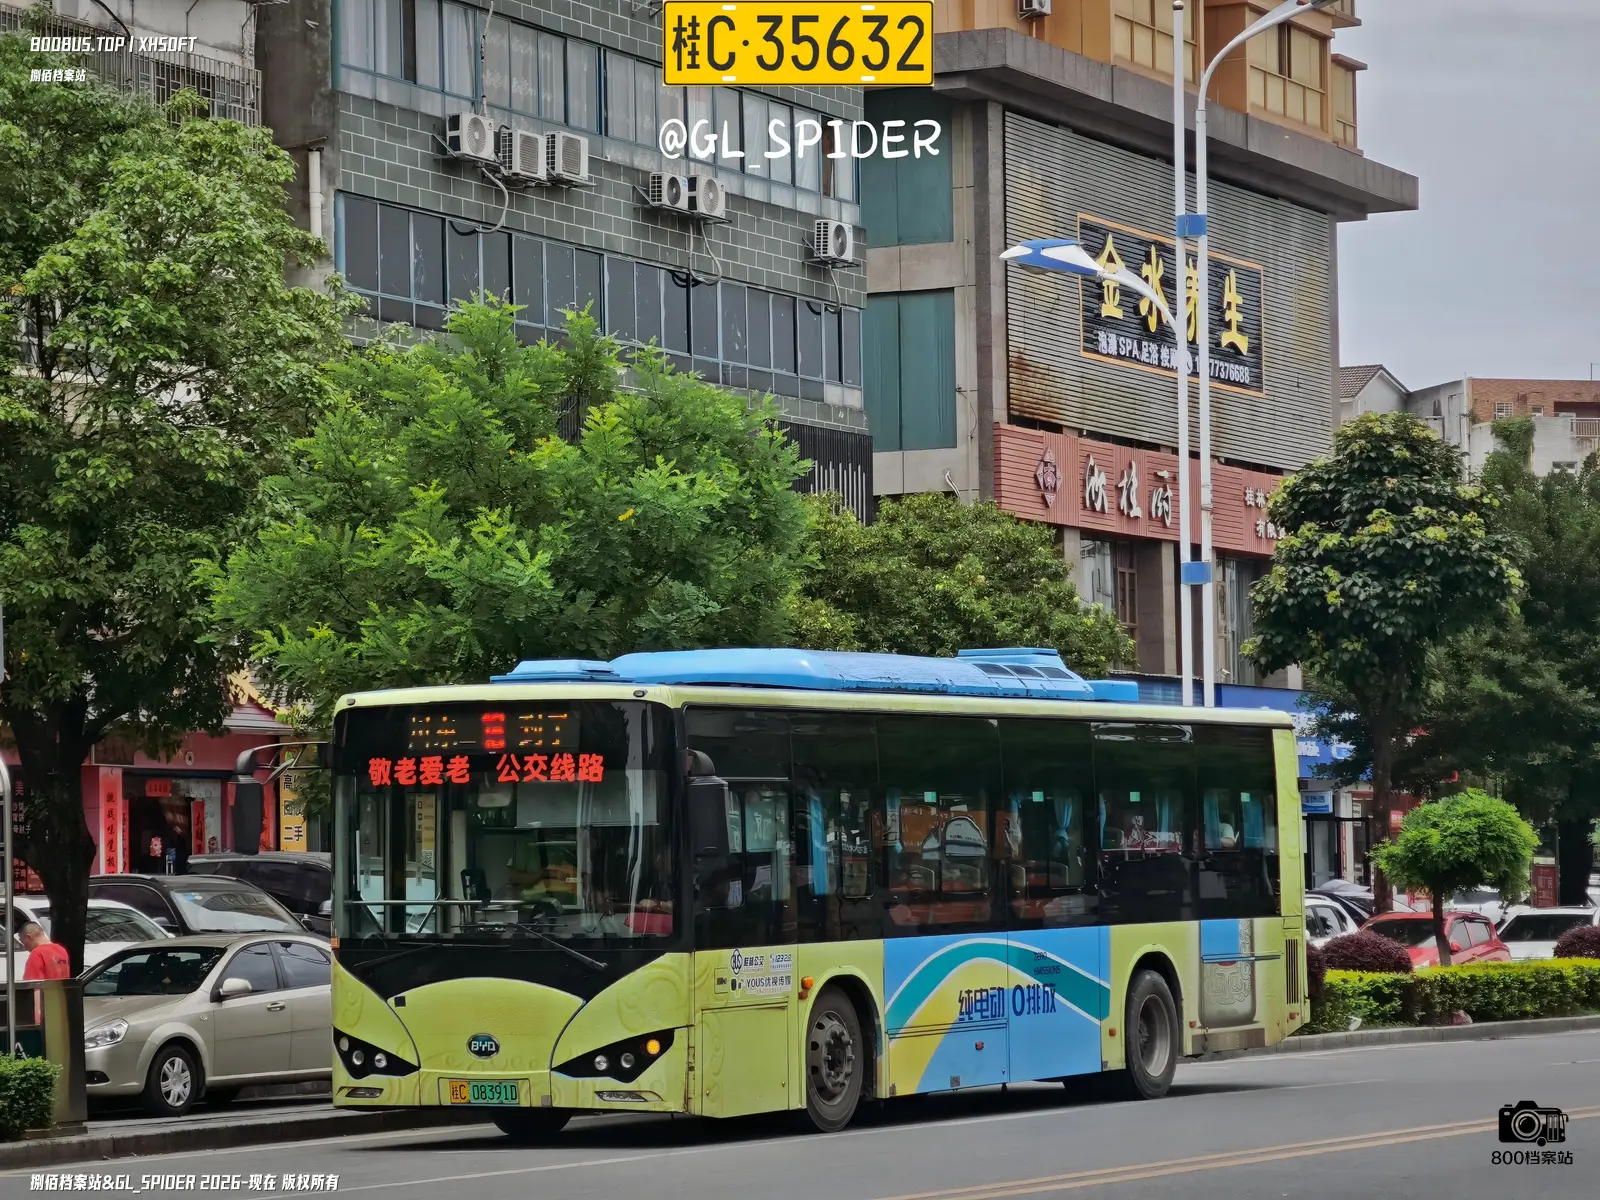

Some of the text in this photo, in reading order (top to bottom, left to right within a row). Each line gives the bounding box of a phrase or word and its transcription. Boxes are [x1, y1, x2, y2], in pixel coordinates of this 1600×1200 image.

[1195, 355, 1250, 384] 177376688
[1244, 486, 1268, 509] 桂林
[367, 752, 605, 787] 敬老爱老 公交线路
[284, 825, 303, 842] 二手
[957, 986, 1005, 1022] 纯电动
[471, 1040, 496, 1052] BYD
